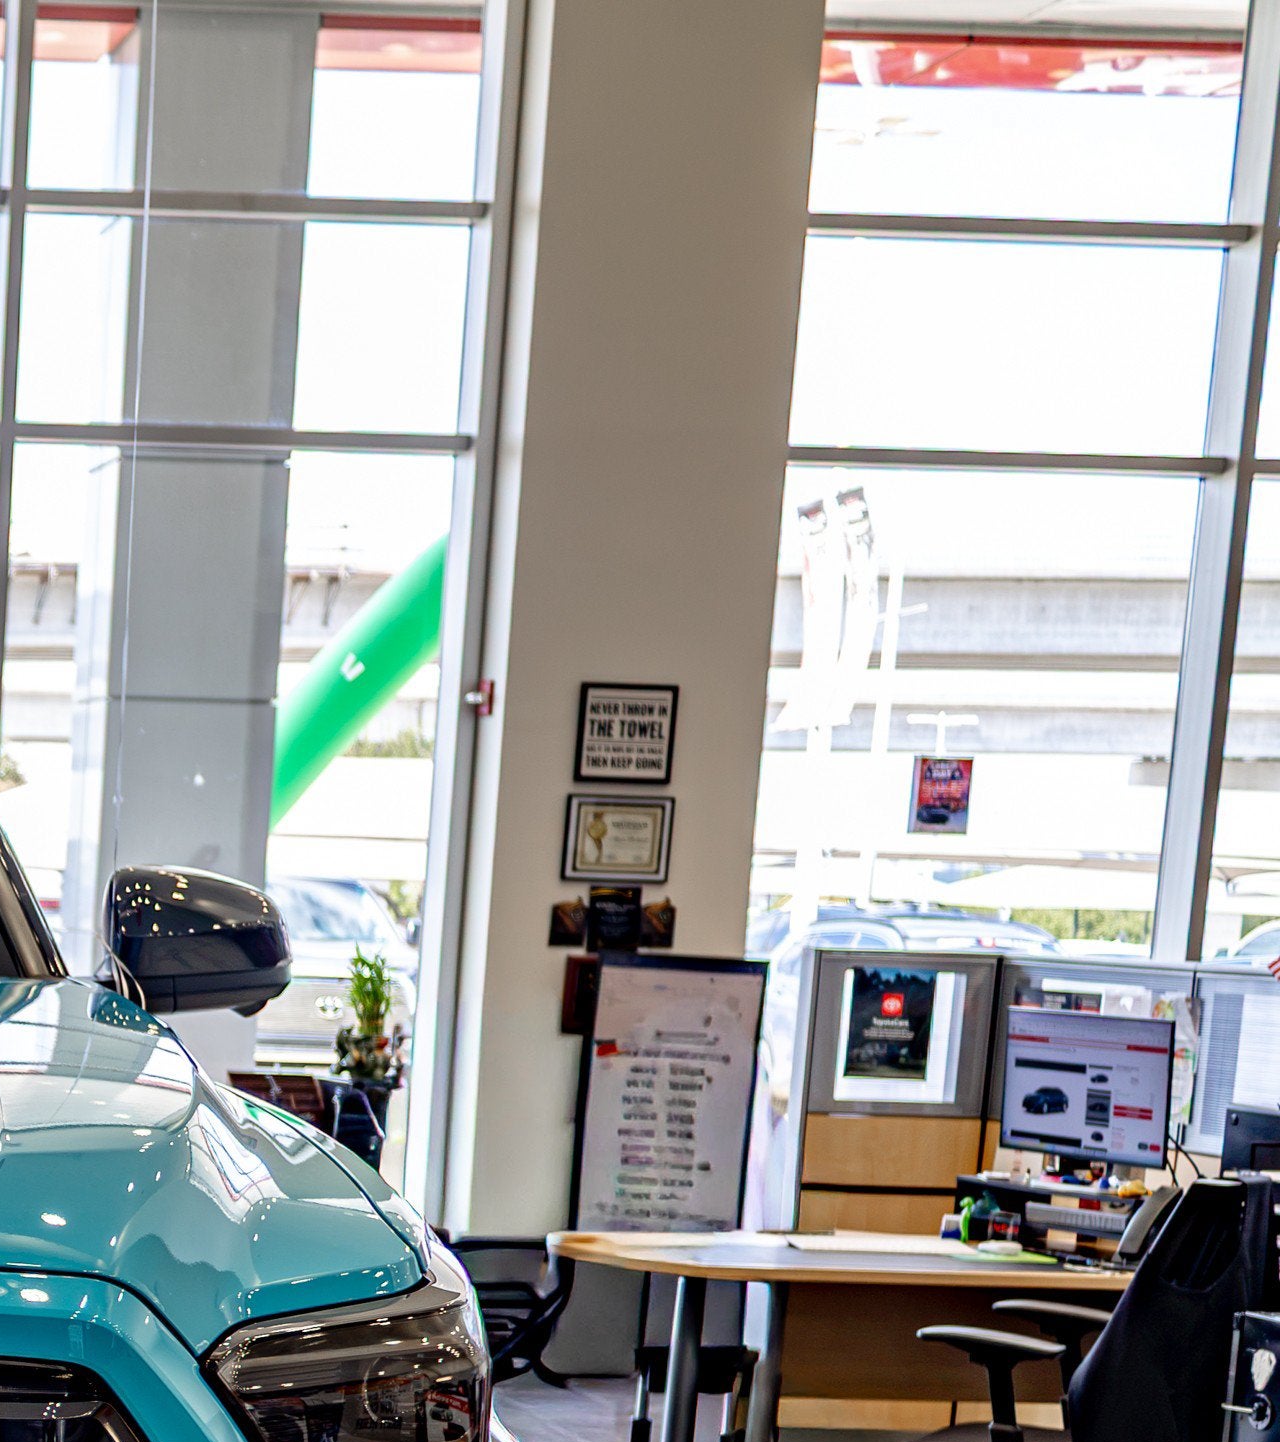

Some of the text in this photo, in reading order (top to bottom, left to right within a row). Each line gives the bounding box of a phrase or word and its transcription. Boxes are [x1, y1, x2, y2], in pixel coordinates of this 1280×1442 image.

[589, 702, 668, 717] NEVER THROW IN
[589, 719, 664, 739] THE TOWEL
[586, 756, 663, 770] THEN KEEP GOING
